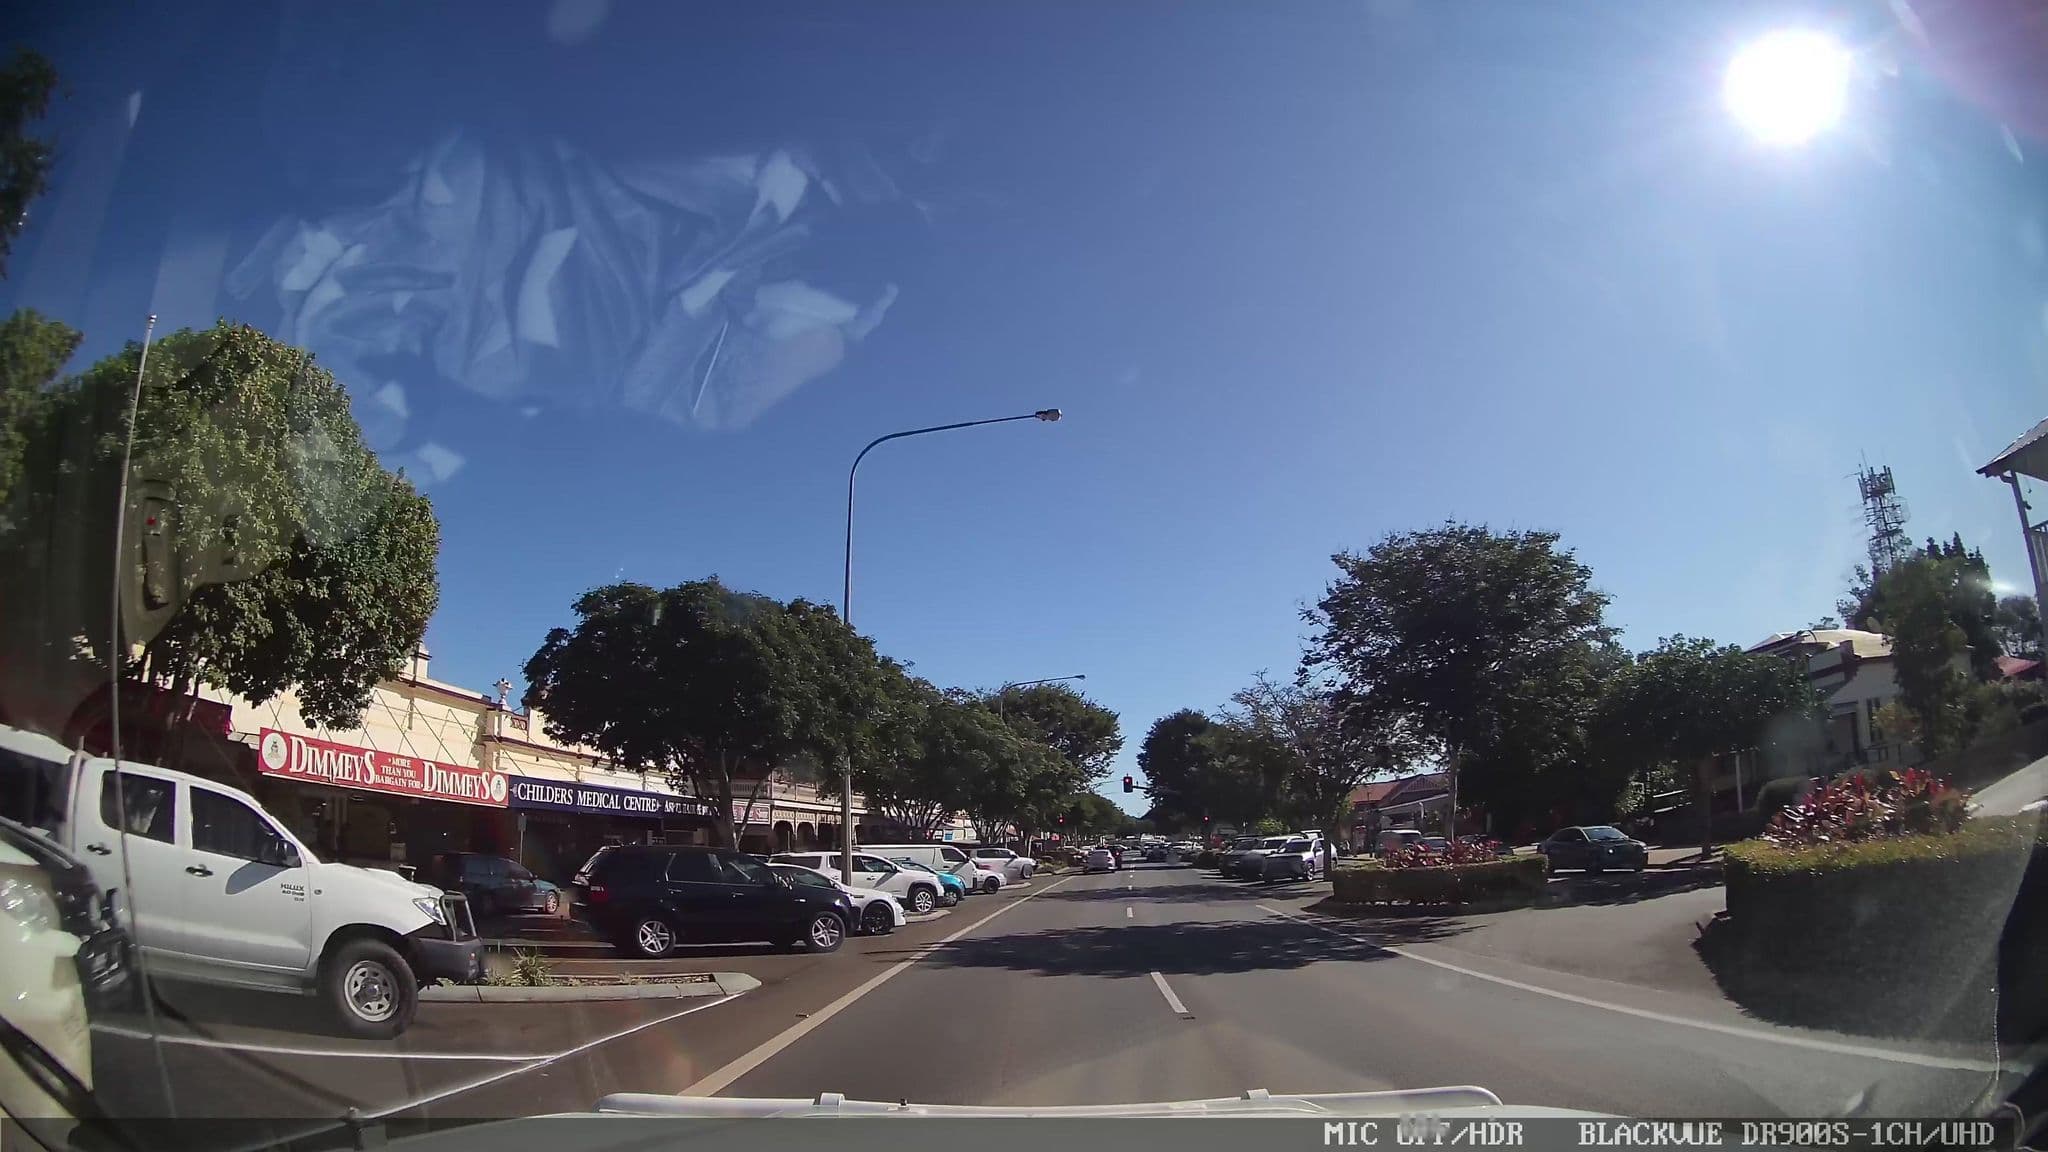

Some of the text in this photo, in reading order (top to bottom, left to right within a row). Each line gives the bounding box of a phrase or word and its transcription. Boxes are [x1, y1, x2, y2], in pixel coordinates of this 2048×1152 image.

[289, 735, 375, 784] DIMMEYS
[392, 757, 411, 767] MORE
[375, 775, 421, 789] BARGAIN FOR
[380, 765, 416, 778] THAN YOU
[422, 761, 490, 800] DIMMEYS
[517, 783, 657, 812] CHILDERS MEDICAL CENTRE
